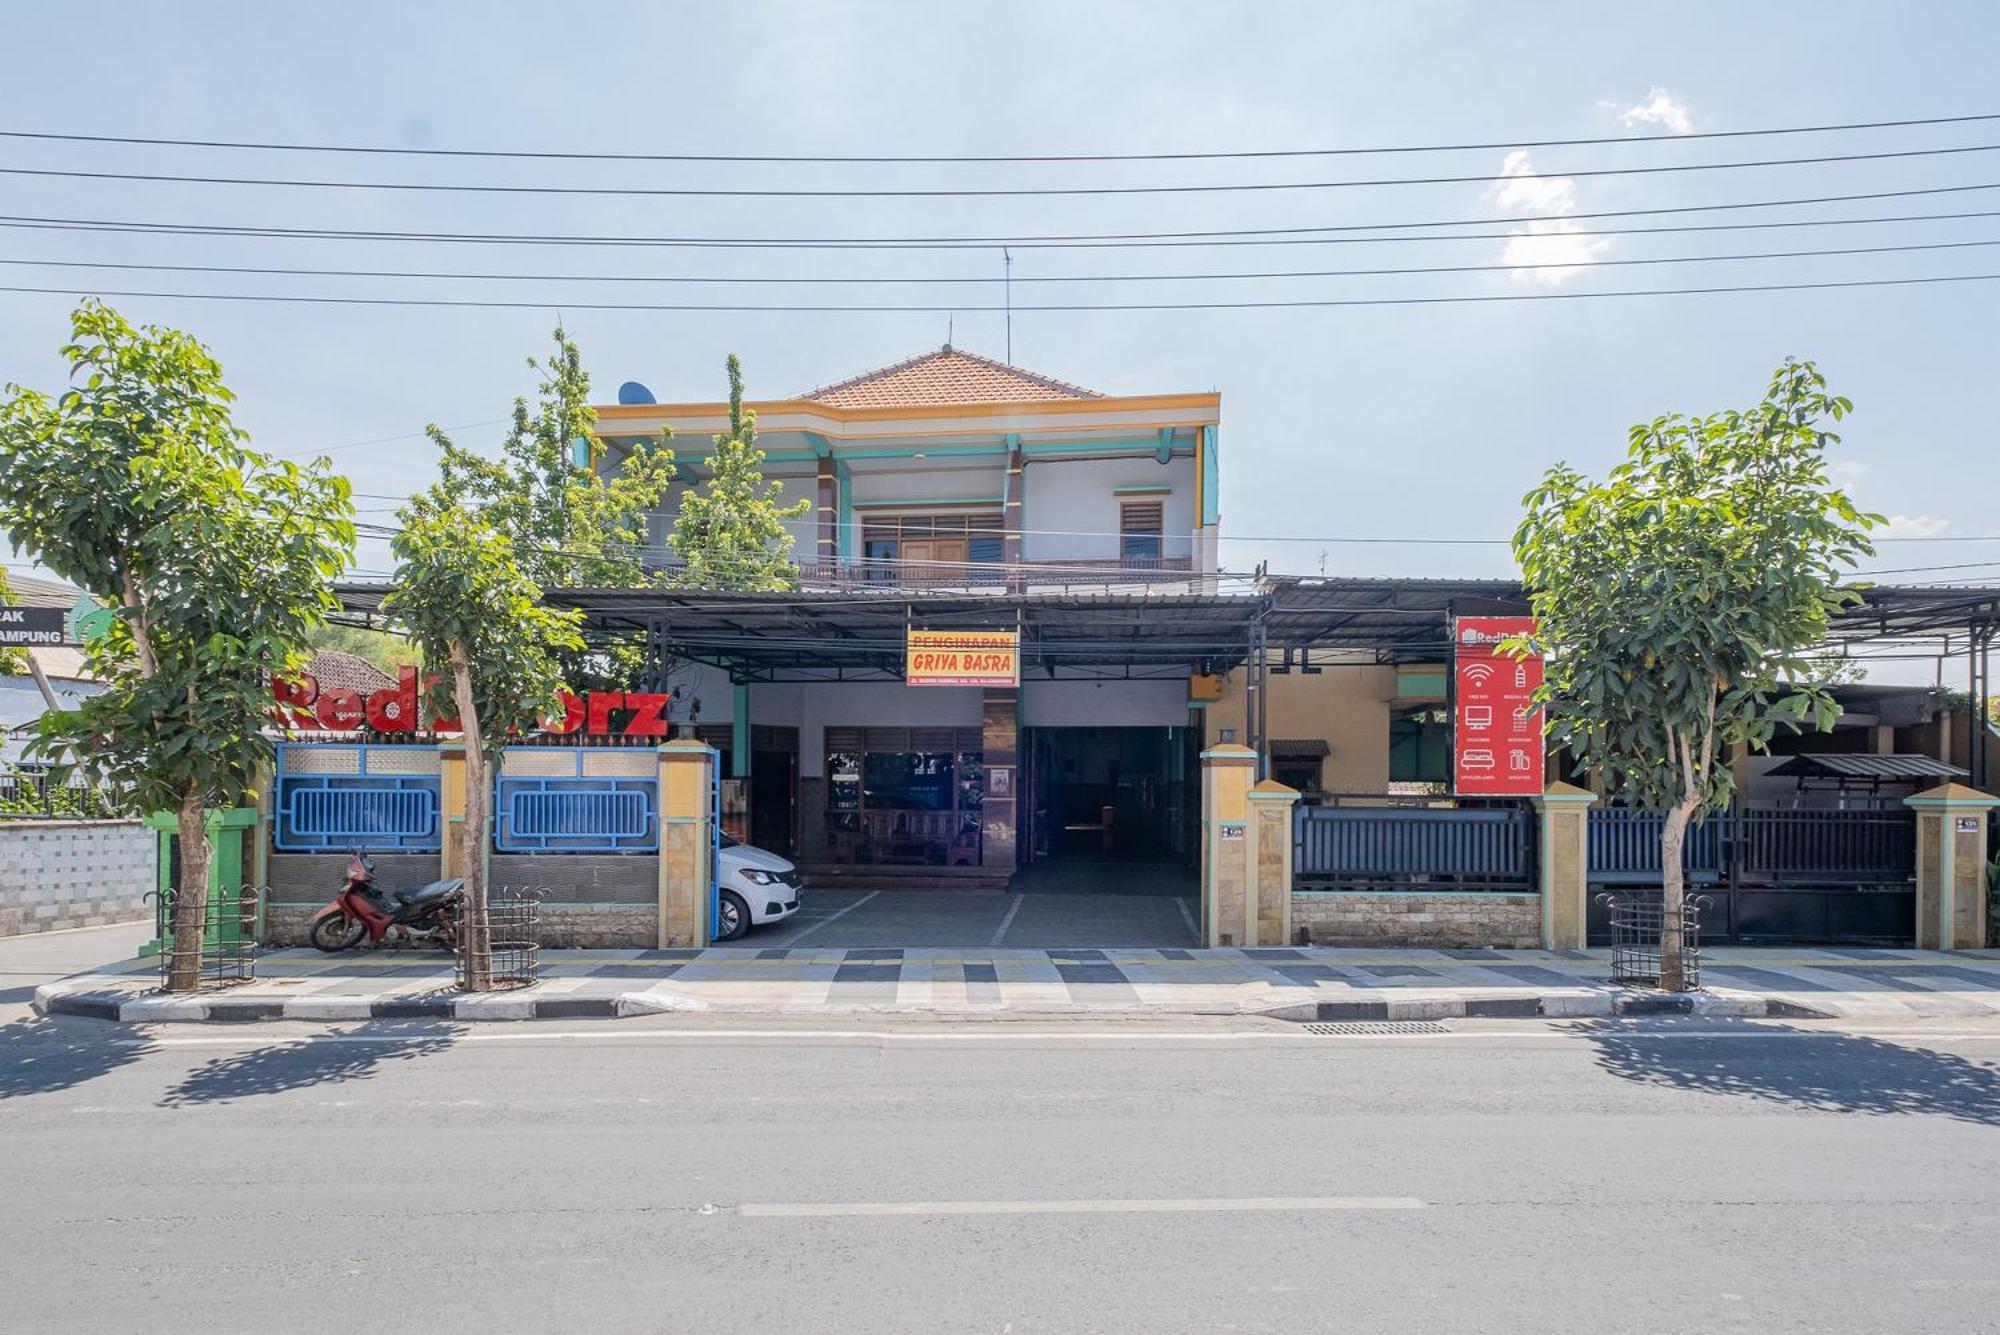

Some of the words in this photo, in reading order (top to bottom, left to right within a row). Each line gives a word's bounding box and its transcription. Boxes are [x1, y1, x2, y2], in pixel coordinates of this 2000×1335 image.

[913, 637, 1010, 648] PENGINAPAN
[913, 654, 958, 671] GRIYA
[964, 655, 1010, 672] BASRA
